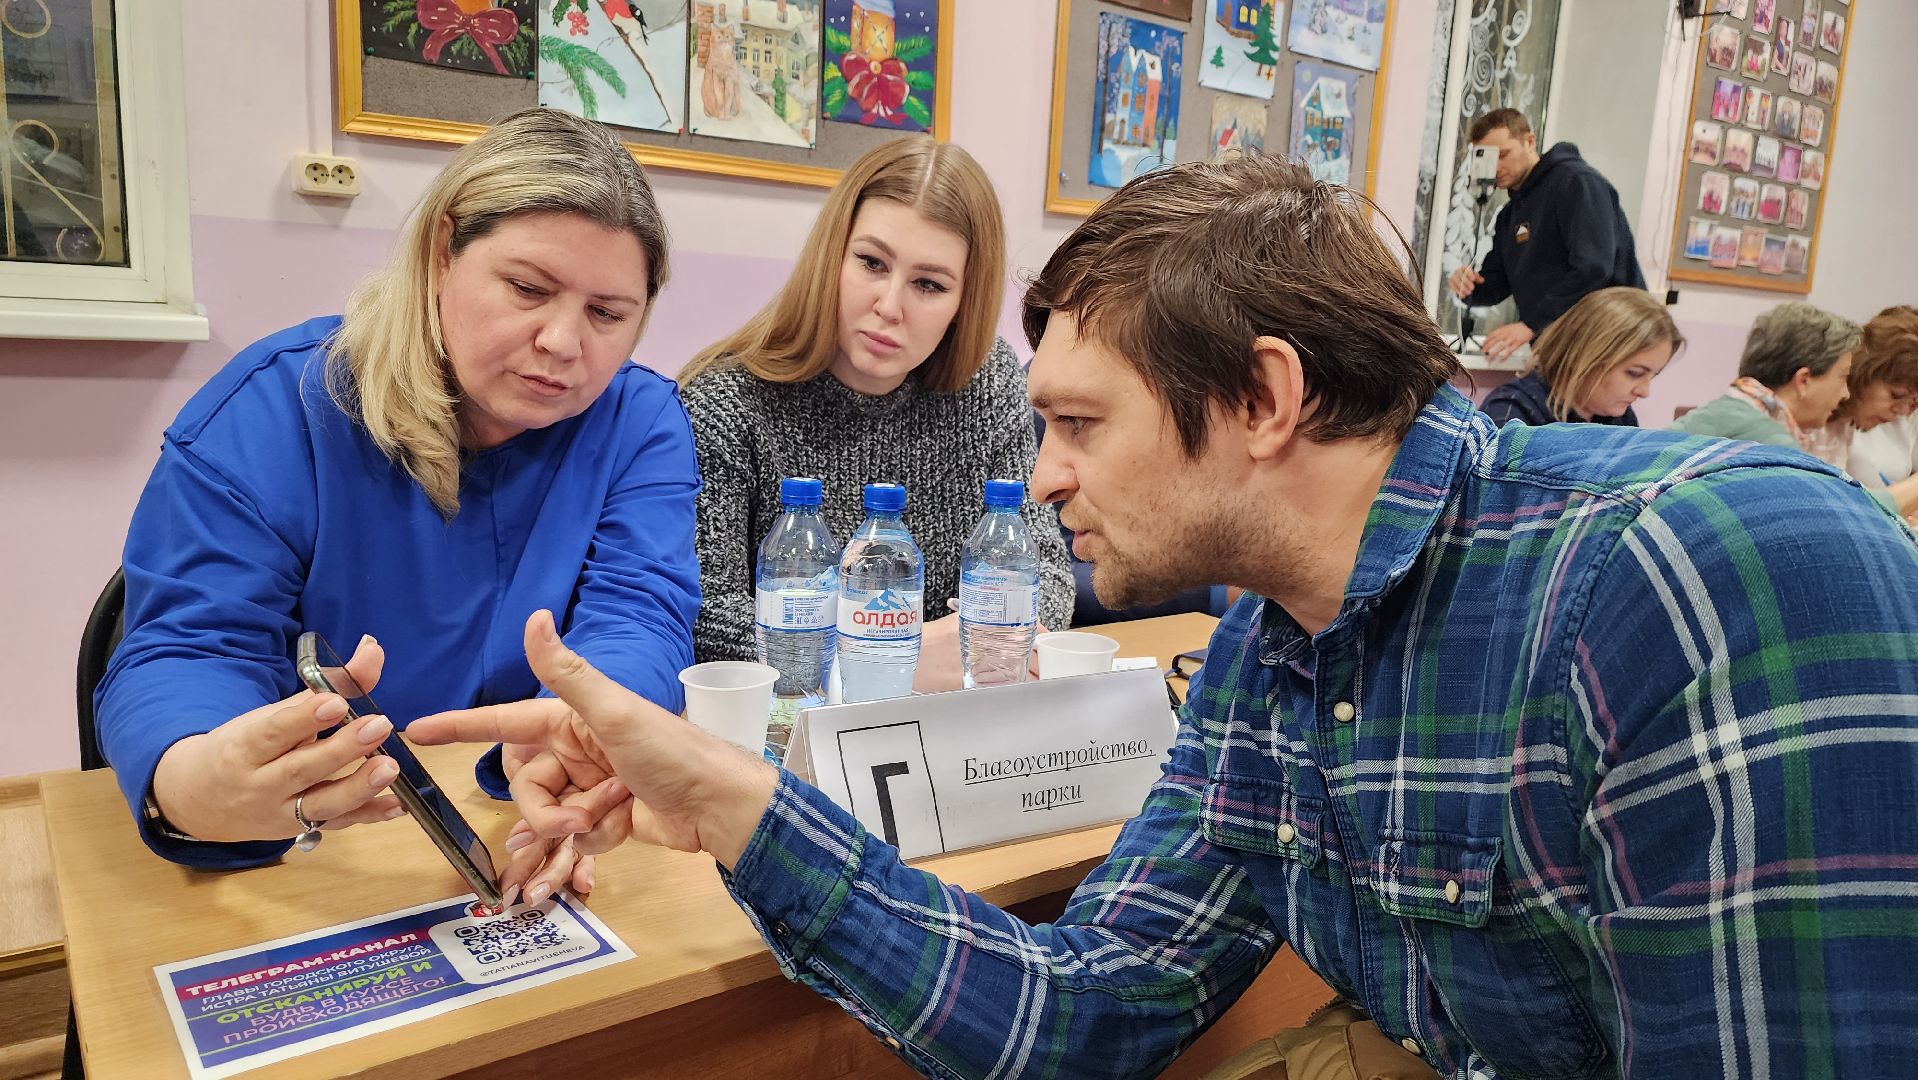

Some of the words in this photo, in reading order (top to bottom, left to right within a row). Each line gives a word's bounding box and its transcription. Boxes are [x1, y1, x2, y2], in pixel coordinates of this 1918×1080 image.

[963, 739, 1154, 781] Благоустройство,
[1021, 783, 1082, 811] парки
[185, 933, 418, 996] ТЕЛЕГРАМ-КАНАЛ
[201, 994, 258, 1012] ИСТРА
[258, 974, 334, 997] ТАТЬЯНЫ
[338, 948, 432, 977] ВИТУШЕВОЙ
[202, 985, 260, 1005] ГЛАВЫ
[263, 959, 366, 988] ГОРОДСКОГО
[368, 944, 425, 961] ОКРУГА
[216, 965, 407, 1024] ОТСКАНИРУЙ
[411, 961, 433, 973] И
[223, 976, 446, 1044] ПРОИСХОДЯЩЕГО!
[251, 1005, 316, 1027] БУДЬ
[320, 998, 337, 1008] В
[341, 976, 415, 1002] КУРСЕ
